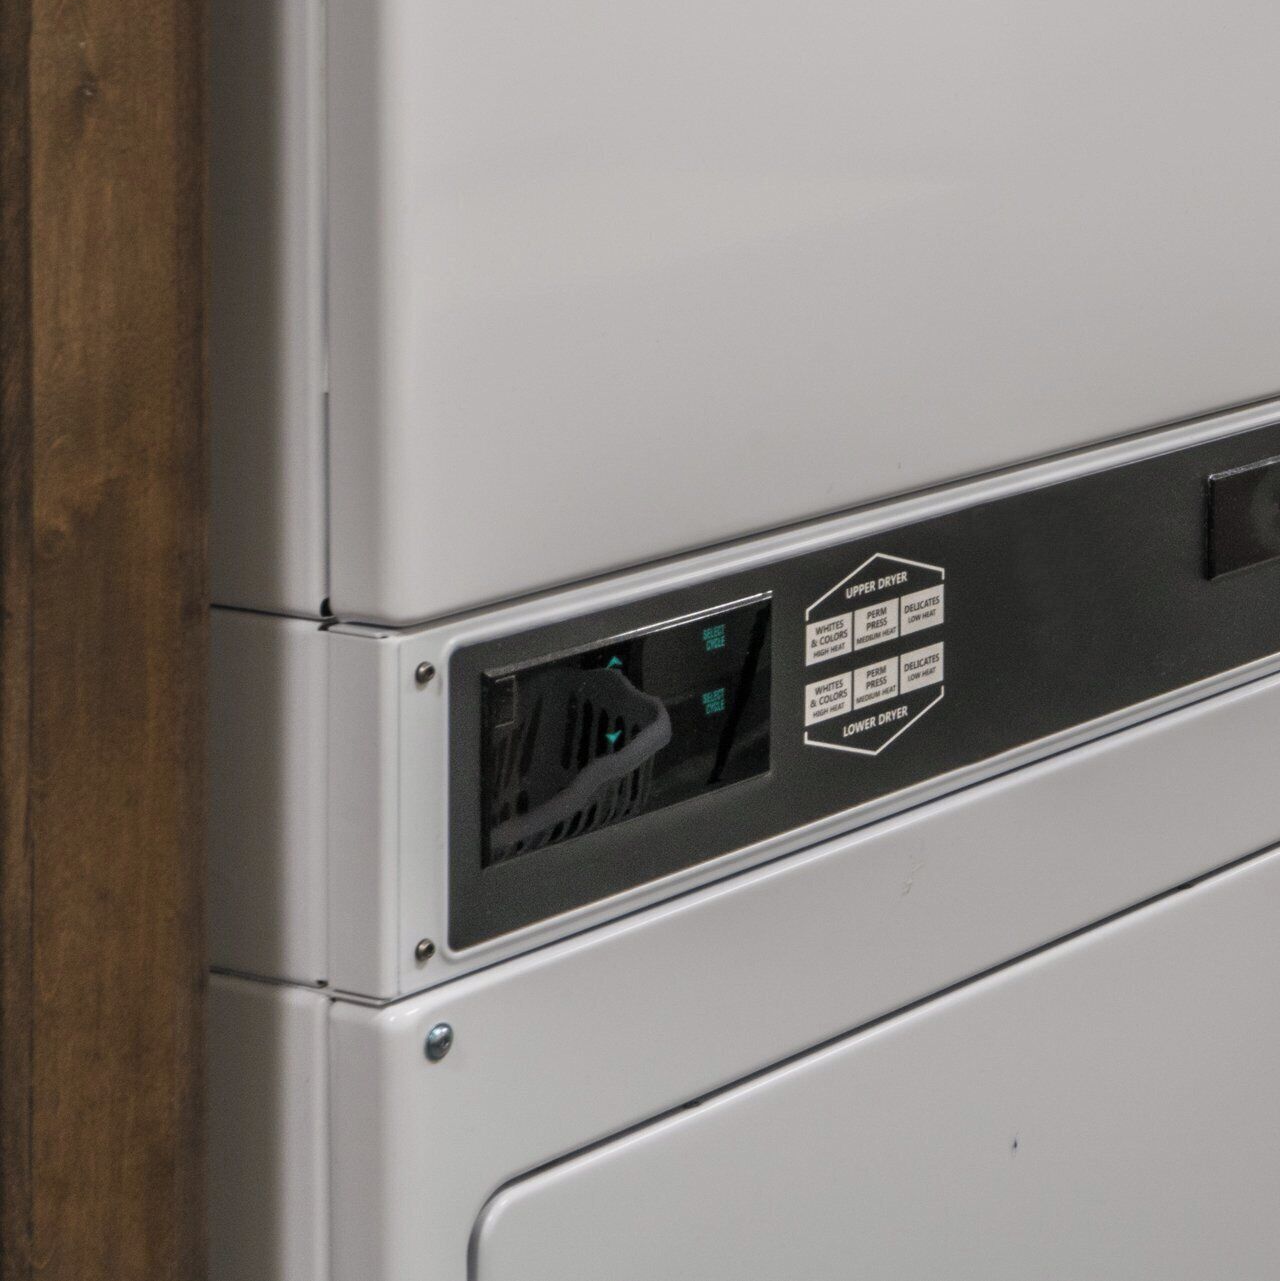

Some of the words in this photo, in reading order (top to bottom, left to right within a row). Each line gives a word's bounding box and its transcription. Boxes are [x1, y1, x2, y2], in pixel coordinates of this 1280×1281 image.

[845, 580, 876, 599] UPPER
[878, 571, 908, 590] DRYER
[866, 607, 887, 619] PERM
[904, 596, 940, 614] DELICATES
[866, 618, 888, 631] PRESS
[908, 614, 921, 624] LOW
[922, 609, 936, 620] HEAT
[703, 624, 725, 640] SELECT
[815, 620, 844, 635] WHITES
[856, 632, 881, 644] MEDIUM
[882, 627, 896, 638] HEAT
[706, 636, 725, 651] CYCLE
[811, 639, 818, 648] &
[820, 630, 848, 646] COLORS
[813, 648, 829, 658] HIGH
[830, 643, 846, 654] HEAT
[903, 653, 940, 672] DELICATES
[866, 665, 887, 679] PERM
[907, 672, 921, 681] LOW
[921, 667, 936, 678] HEAT
[815, 679, 844, 695] WHITES
[865, 676, 888, 690] PRESS
[702, 688, 725, 704] SELECT
[810, 698, 817, 708] &
[819, 689, 848, 705] COLORS
[856, 691, 881, 704] MEDIUM
[882, 685, 896, 697] HEAT
[706, 700, 725, 714] CYCLE
[813, 708, 829, 718] HIGH
[830, 702, 845, 713] HEAT
[843, 716, 876, 738] LOWER
[878, 705, 908, 726] DRYER
